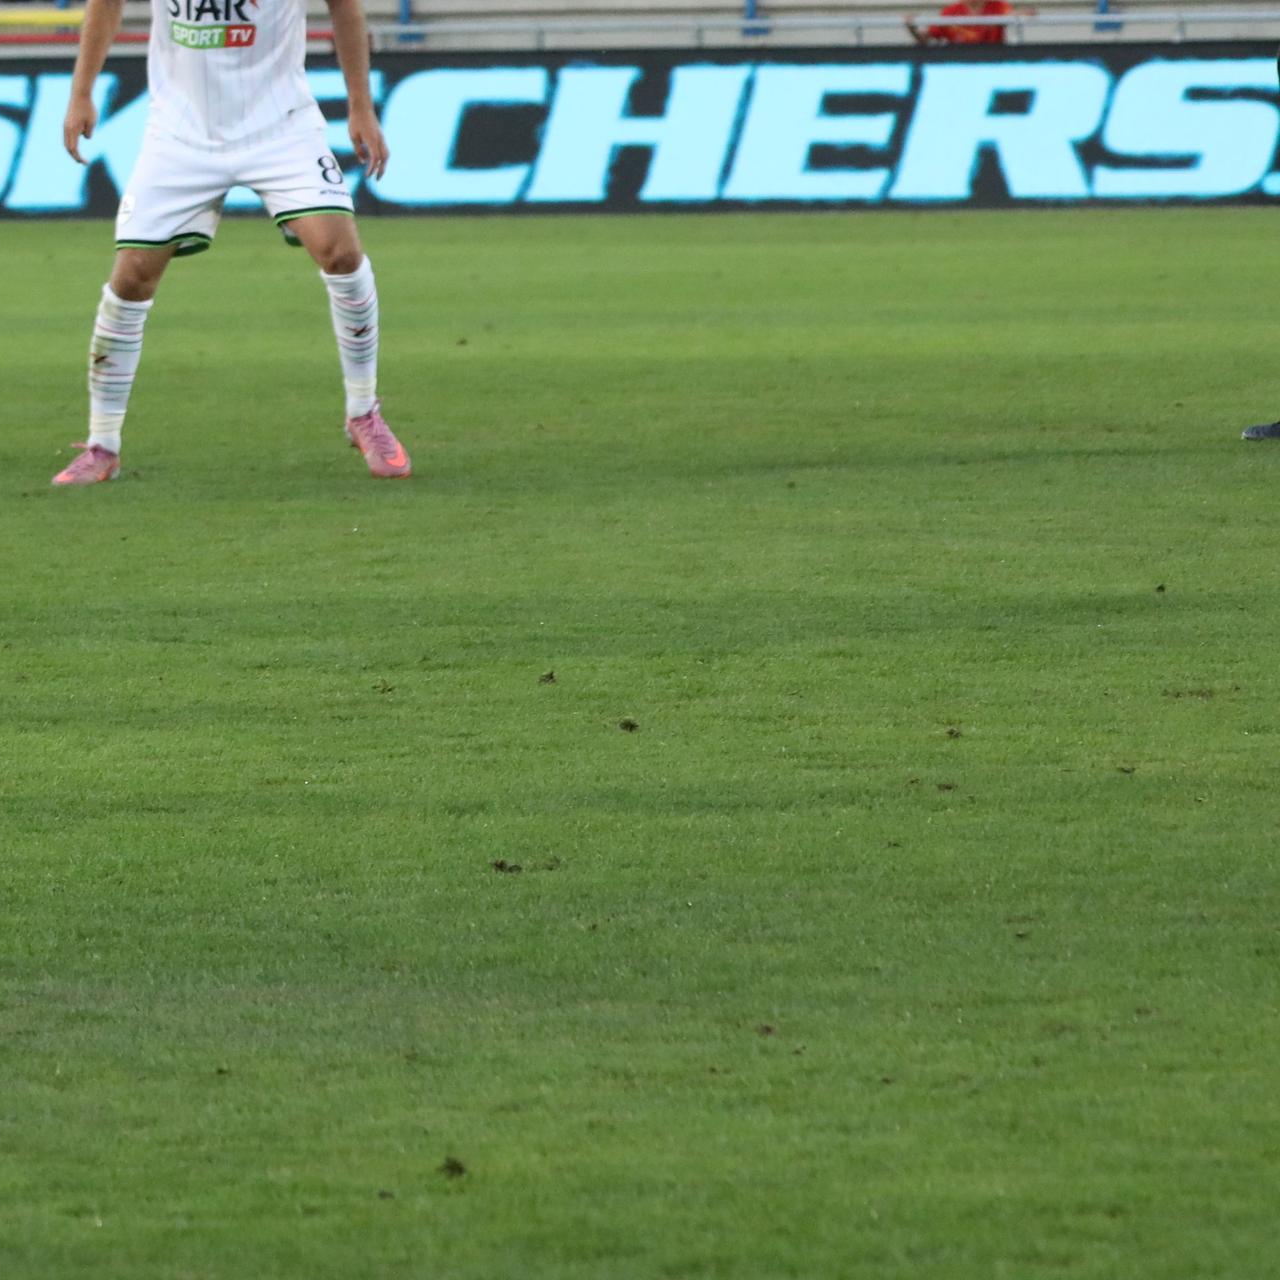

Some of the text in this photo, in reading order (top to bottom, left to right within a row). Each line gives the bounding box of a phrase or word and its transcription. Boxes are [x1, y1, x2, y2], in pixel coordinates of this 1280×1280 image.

[172, 26, 252, 45] SPORT TV
[317, 155, 343, 185] 8
